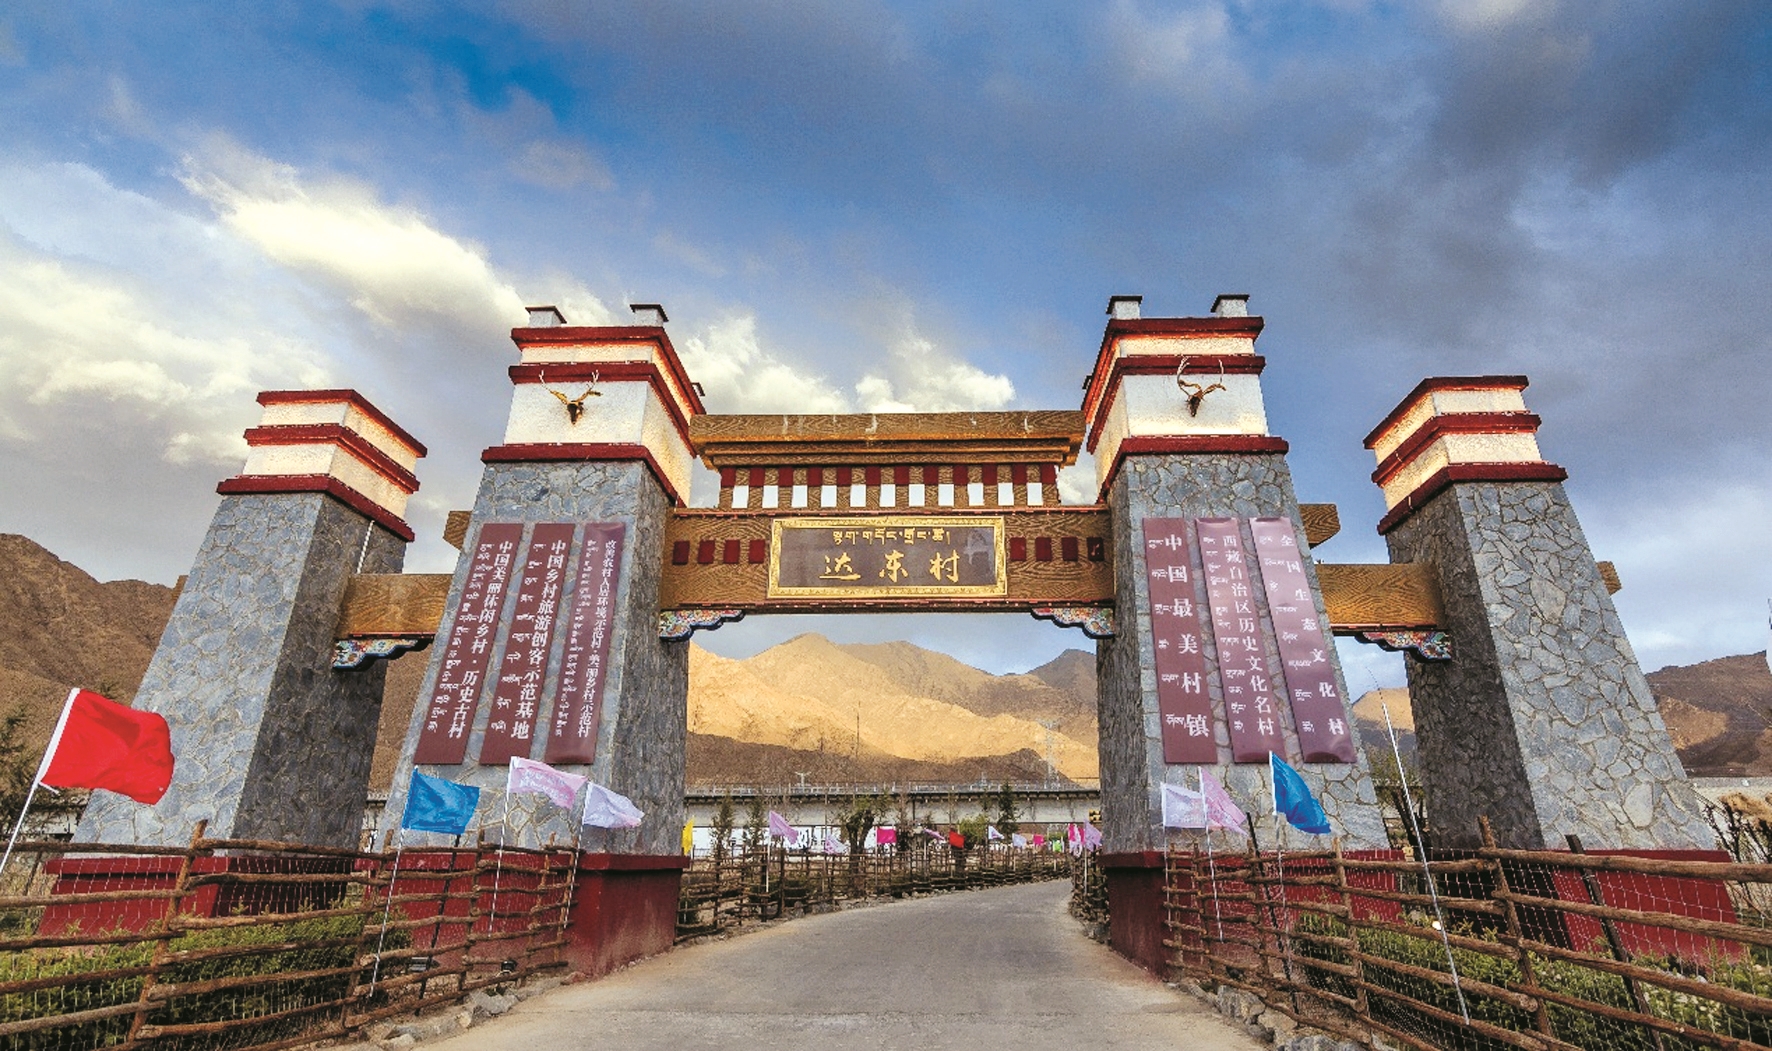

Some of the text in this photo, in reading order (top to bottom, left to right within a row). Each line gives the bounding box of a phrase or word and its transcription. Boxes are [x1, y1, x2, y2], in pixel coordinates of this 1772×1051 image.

[447, 540, 513, 739] 中国美丽休闲乡村·历史古村
[510, 539, 567, 740] 中国乡村旅游创客示范基地
[818, 549, 961, 583] 达东村
[1164, 533, 1209, 738] 中国最美村镇
[1222, 534, 1275, 736] 西藏自治区历史文化名村
[1280, 535, 1345, 736] 全国生态文化村
